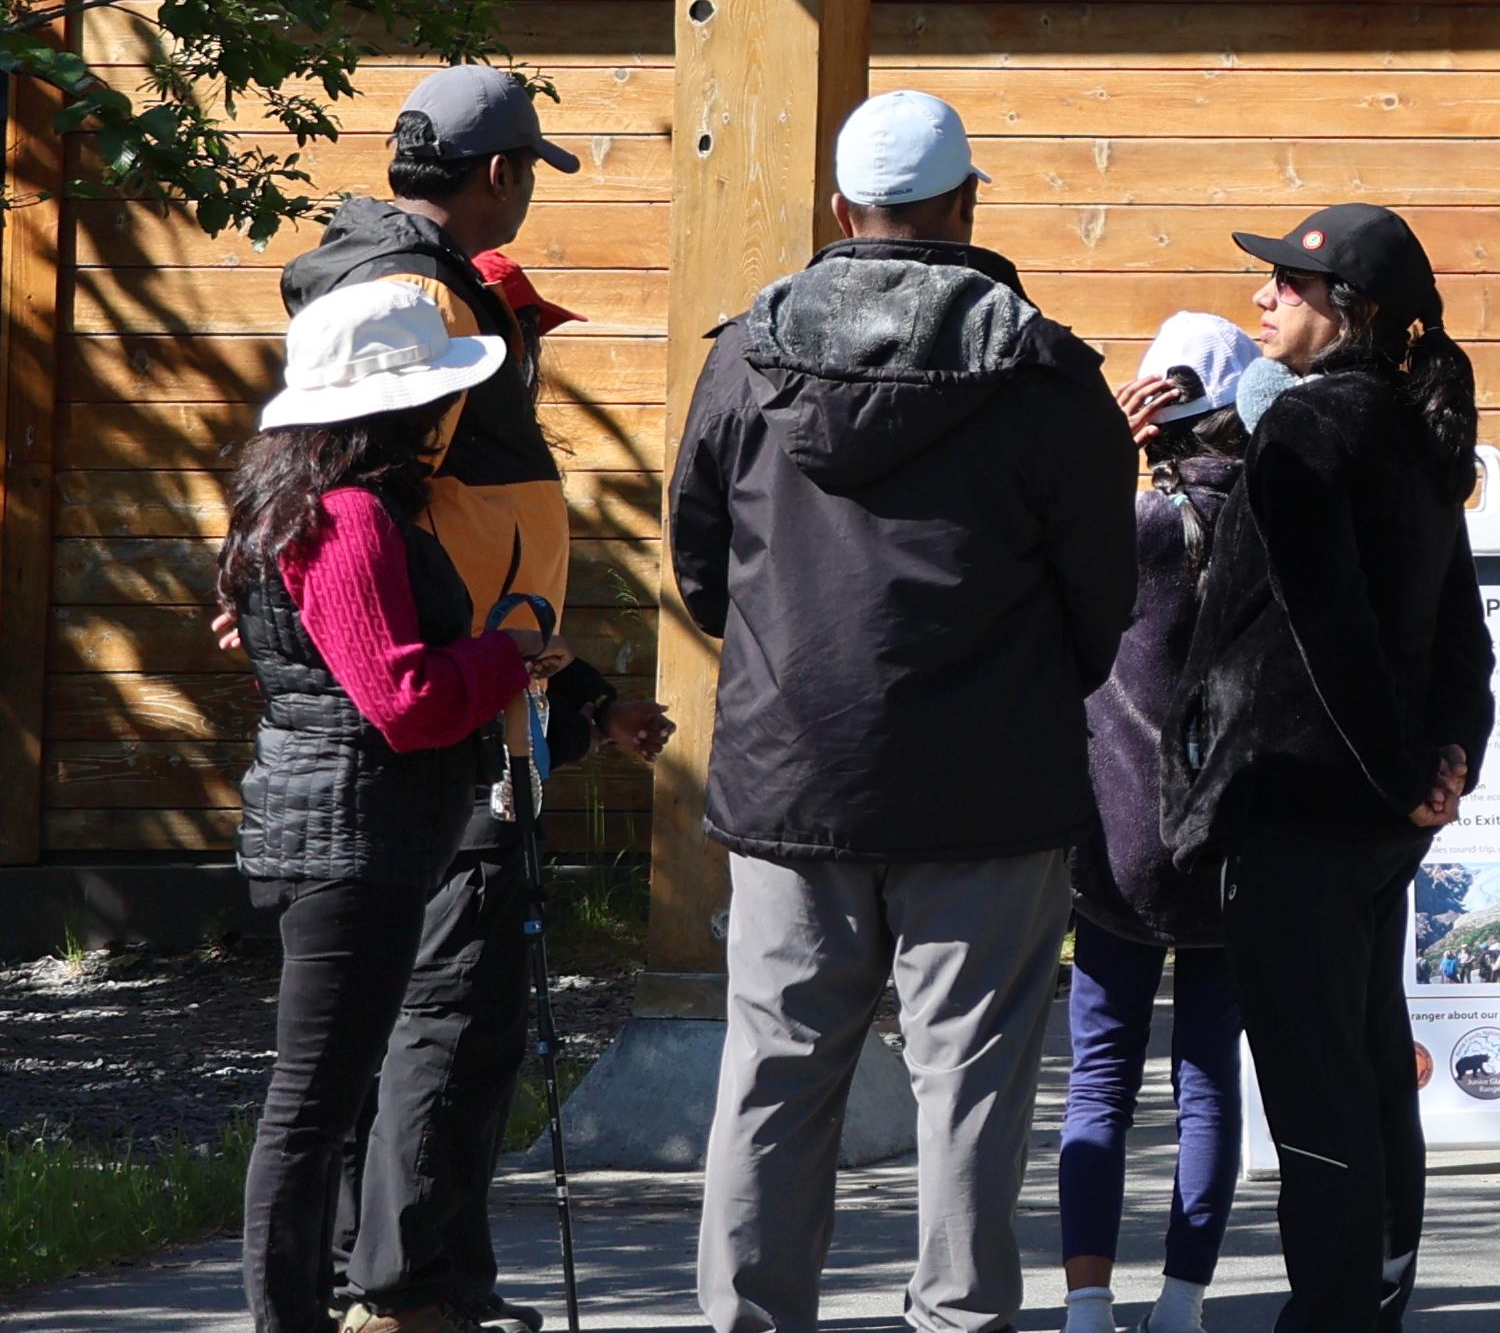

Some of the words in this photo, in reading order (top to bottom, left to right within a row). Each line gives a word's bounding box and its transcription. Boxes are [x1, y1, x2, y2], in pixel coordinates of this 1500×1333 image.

[1470, 793, 1484, 802] the
[1457, 816, 1472, 826] to
[1411, 1012, 1446, 1023] ranger
[1447, 1010, 1478, 1020] about
[1480, 1012, 1498, 1020] our
